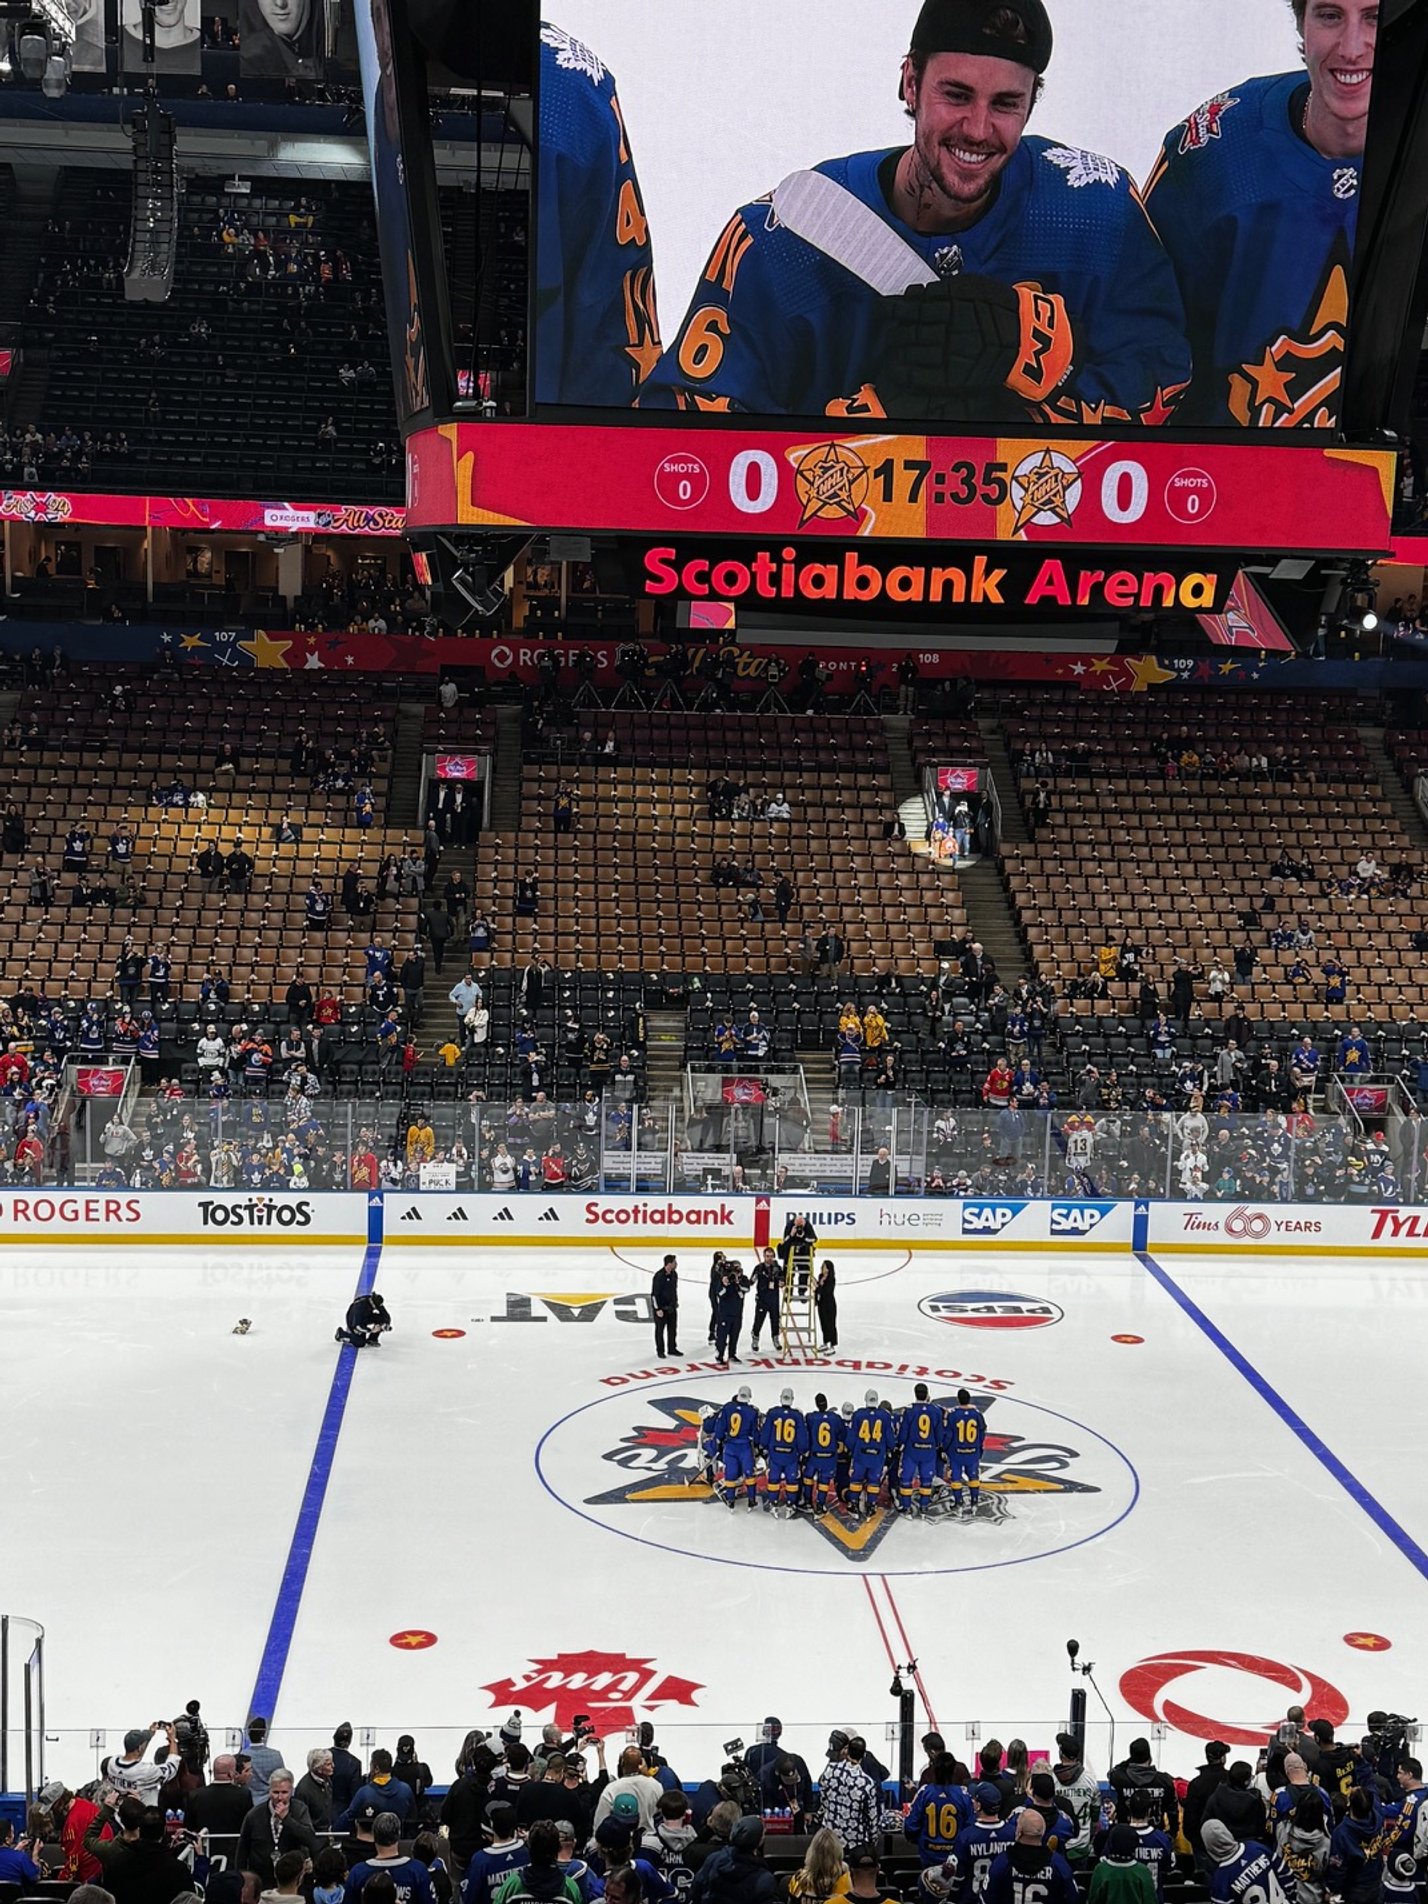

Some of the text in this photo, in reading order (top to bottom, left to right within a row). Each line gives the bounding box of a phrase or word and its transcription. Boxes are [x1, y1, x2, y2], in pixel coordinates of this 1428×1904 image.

[616, 179, 647, 246] 4
[678, 305, 731, 379] 6
[663, 462, 700, 474] SHOTS
[678, 480, 691, 499] 0
[728, 449, 779, 514] 0
[818, 473, 842, 495] NHL
[873, 458, 1009, 506] 17:35
[1031, 480, 1058, 501] NHL
[1100, 460, 1149, 523] 0
[1174, 477, 1208, 489] SHOTS
[1187, 494, 1200, 515] 0
[279, 515, 310, 523] ROGERS
[644, 547, 1217, 609] Scotiabank Arena
[214, 631, 236, 641] 107
[918, 653, 940, 664] 108
[1173, 658, 1194, 670] 109
[1073, 1138, 1087, 1151] 13
[13, 1199, 141, 1223] ROGERS
[585, 1201, 734, 1225] Scotiabank
[880, 1208, 921, 1226] hue
[963, 1207, 1012, 1230] SAP
[1051, 1208, 1102, 1231] SAP
[1183, 1205, 1322, 1239] Tims 60 YEARS
[1370, 1209, 1428, 1240] TYL
[490, 1292, 655, 1323] CAT
[929, 1304, 1053, 1315] PEPSI
[599, 1357, 1015, 1391] Scotiabank Arena
[729, 1412, 742, 1437] 9
[774, 1417, 796, 1443] 16
[818, 1422, 831, 1447] 6
[858, 1419, 883, 1443] 44
[919, 1414, 931, 1439] 9
[956, 1418, 977, 1443] 16
[509, 1670, 679, 1707] Tims
[925, 1802, 958, 1839] 16
[1079, 1800, 1091, 1826] 4
[1231, 1853, 1271, 1894] MATTHEWS
[1013, 1881, 1049, 1904] 16
